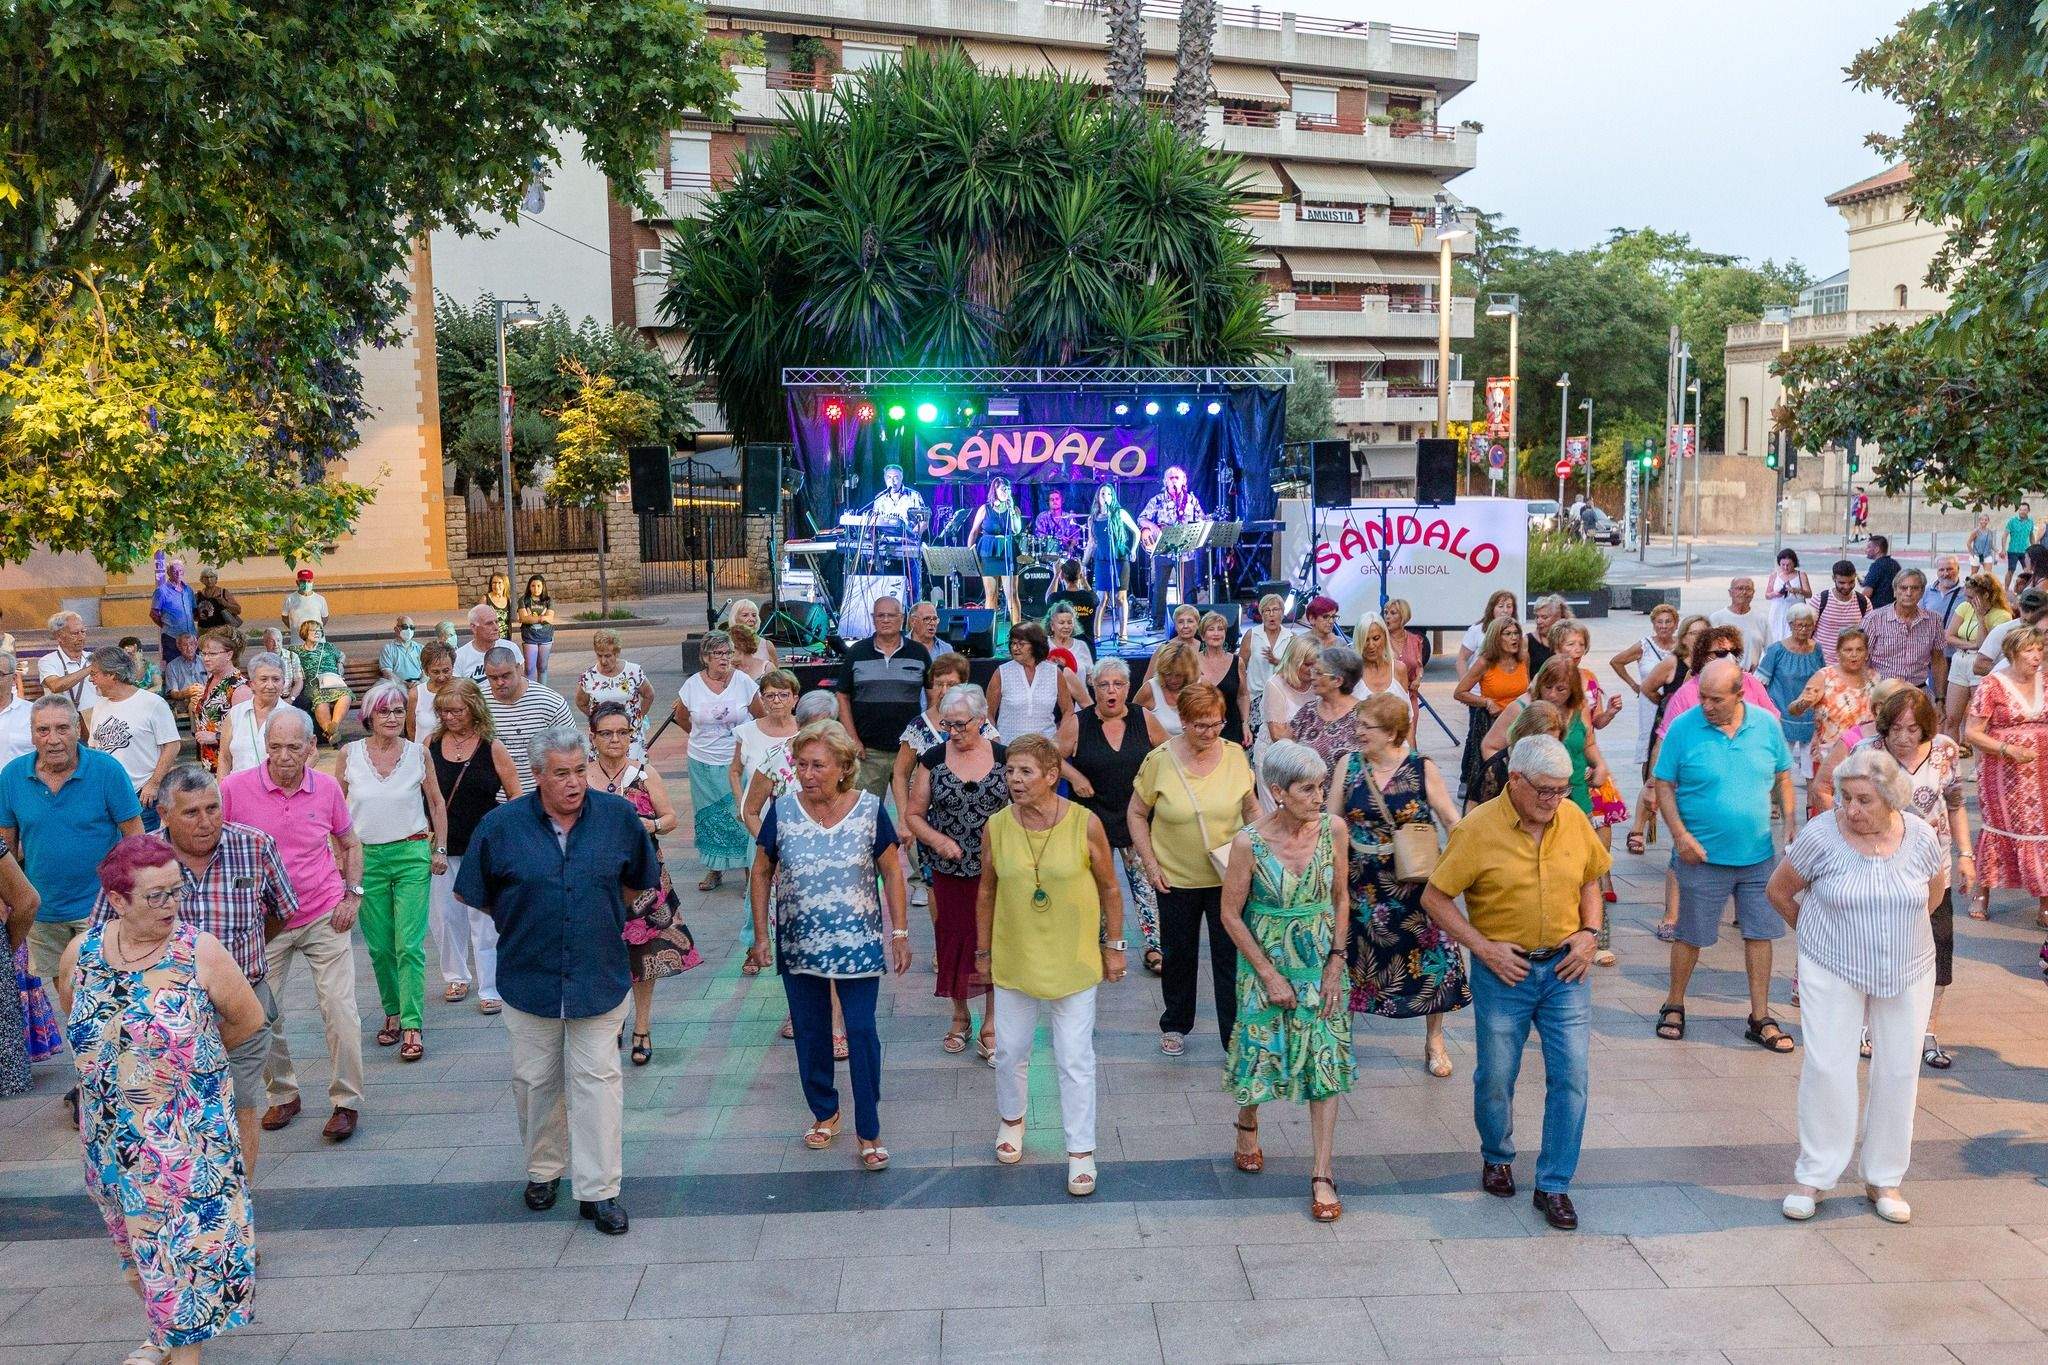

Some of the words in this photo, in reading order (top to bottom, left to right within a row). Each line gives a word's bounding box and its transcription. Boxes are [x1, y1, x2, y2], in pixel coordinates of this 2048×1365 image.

[1307, 209, 1354, 221] AMNISTIA
[927, 429, 1147, 477] SÁNDALO
[1314, 515, 1500, 575] SÁNDALO
[1360, 565, 1396, 575] GRP:
[1399, 564, 1450, 575] MUSICAL
